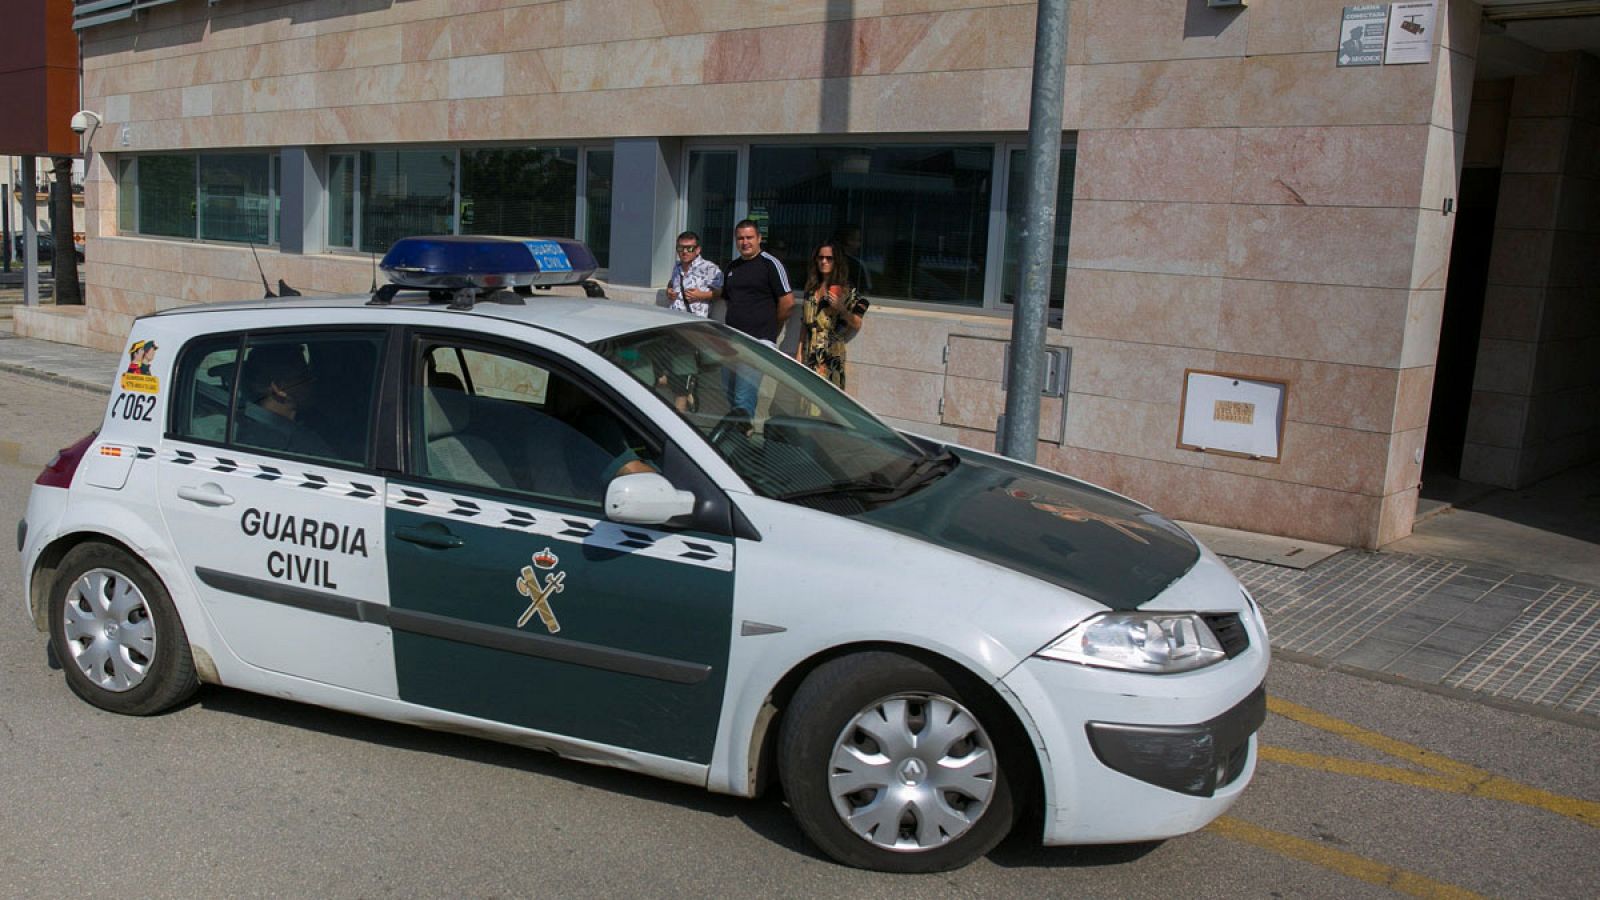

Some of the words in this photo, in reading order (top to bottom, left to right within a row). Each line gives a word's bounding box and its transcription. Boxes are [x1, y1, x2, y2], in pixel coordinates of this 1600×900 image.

[529, 243, 562, 255] GUARDIA
[544, 256, 563, 268] CIVIL
[123, 393, 157, 421] 062
[241, 508, 368, 558] GUARDIA
[267, 550, 337, 589] CIVIL
